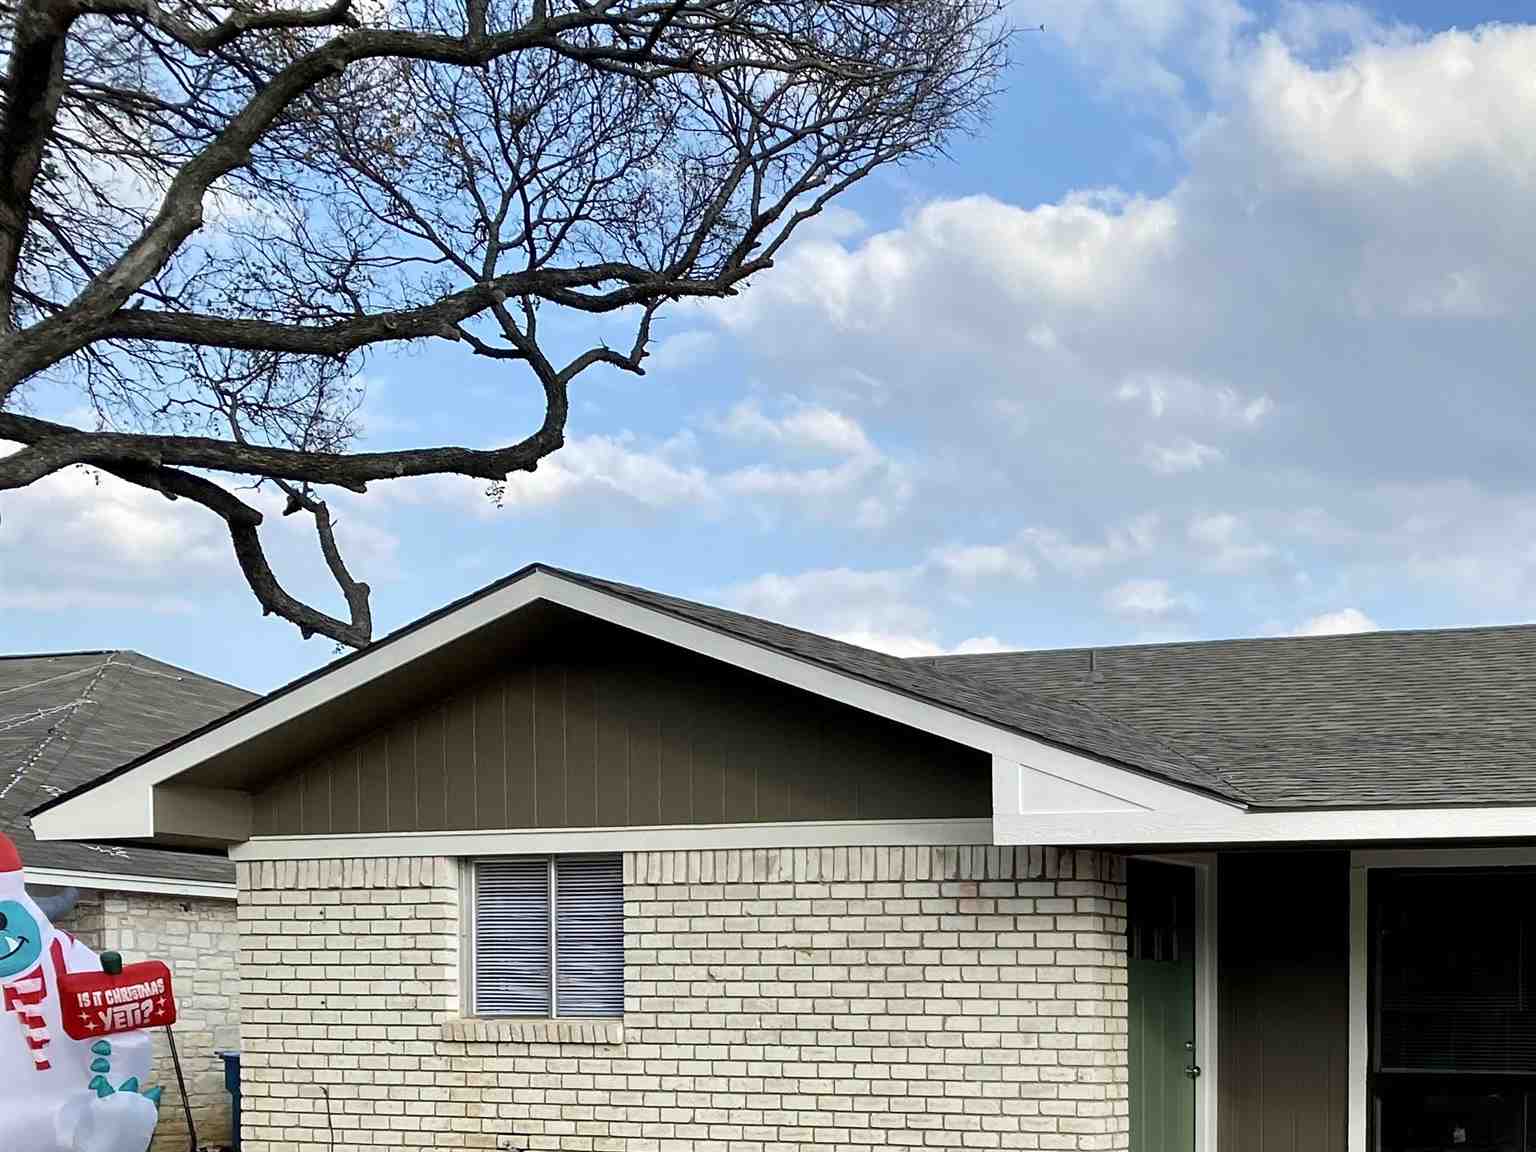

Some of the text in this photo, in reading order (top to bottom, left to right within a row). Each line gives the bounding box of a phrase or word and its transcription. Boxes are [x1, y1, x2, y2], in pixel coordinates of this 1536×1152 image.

[77, 978, 165, 1007] IS IT CHRISTMAS
[98, 998, 154, 1031] YETI?
